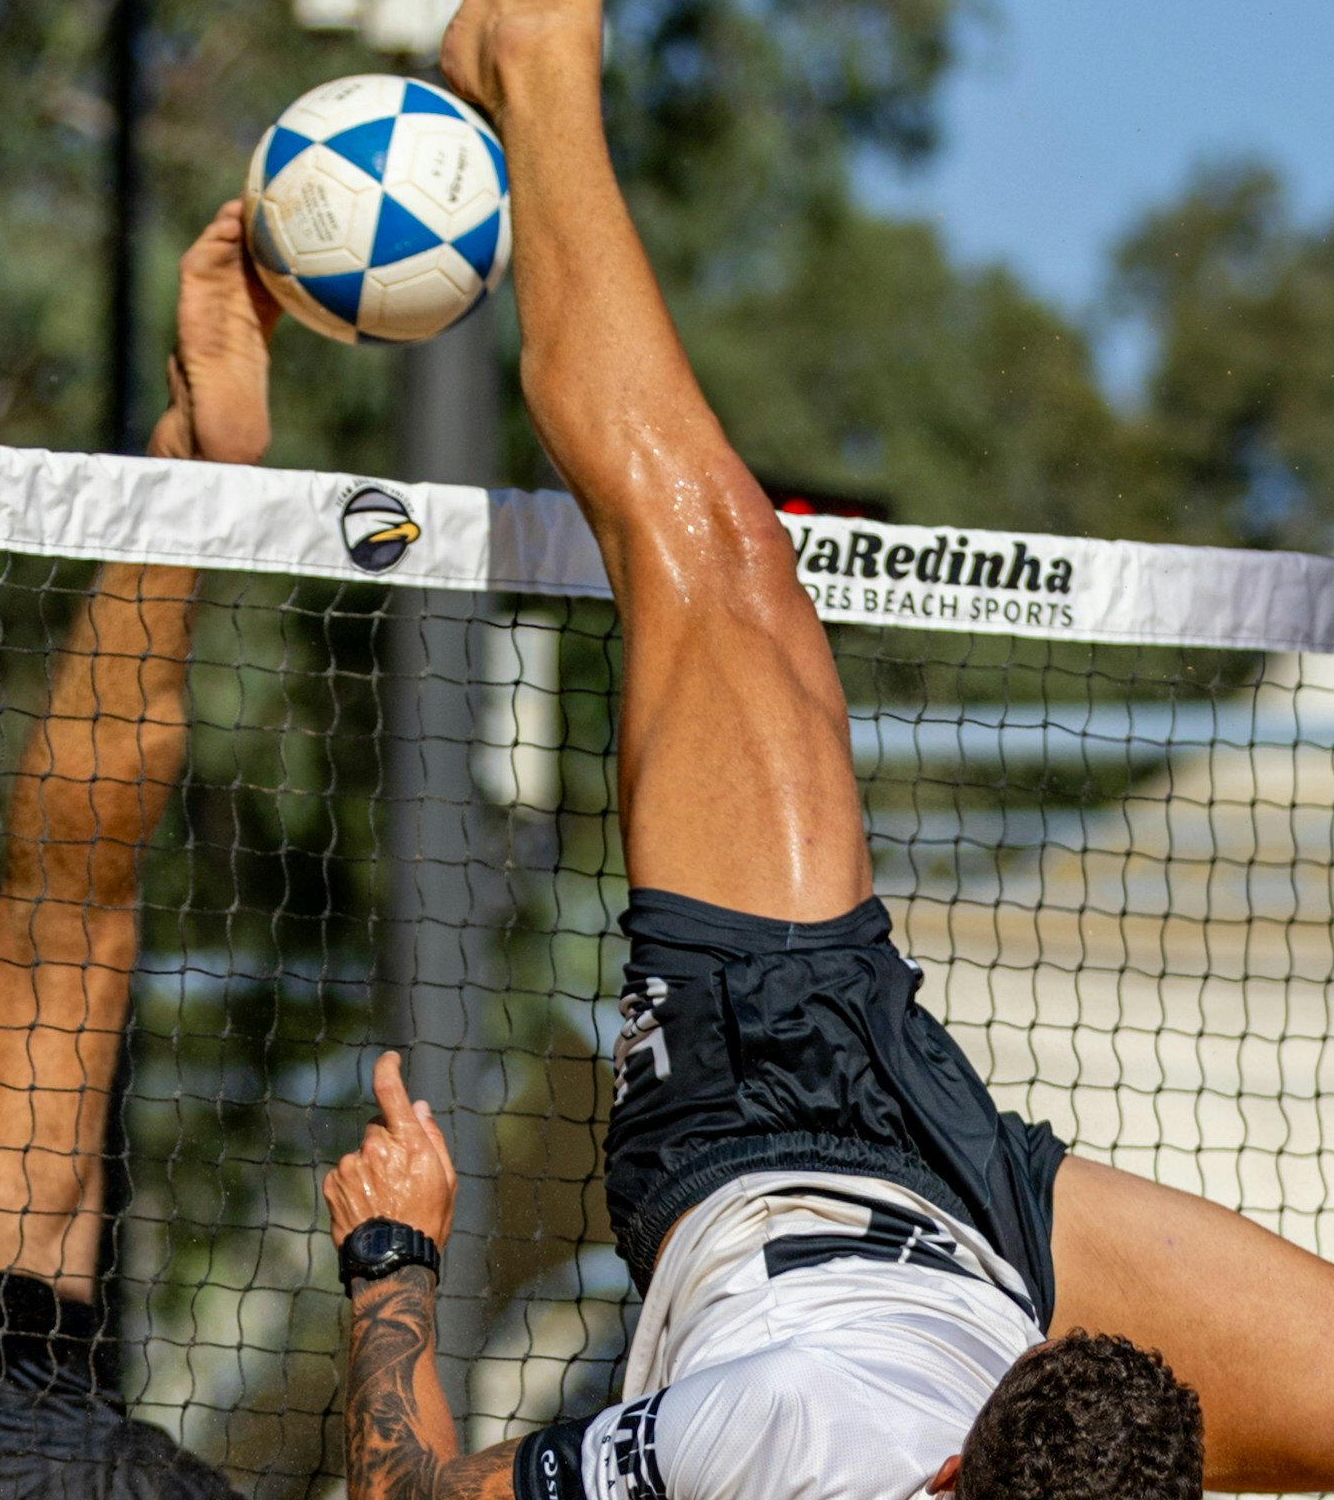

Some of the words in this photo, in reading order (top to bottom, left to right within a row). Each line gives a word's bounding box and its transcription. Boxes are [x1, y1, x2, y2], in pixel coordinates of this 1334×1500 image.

[803, 583, 852, 610] DES
[863, 588, 959, 618] BEACH
[969, 596, 1074, 627] SPORTS
